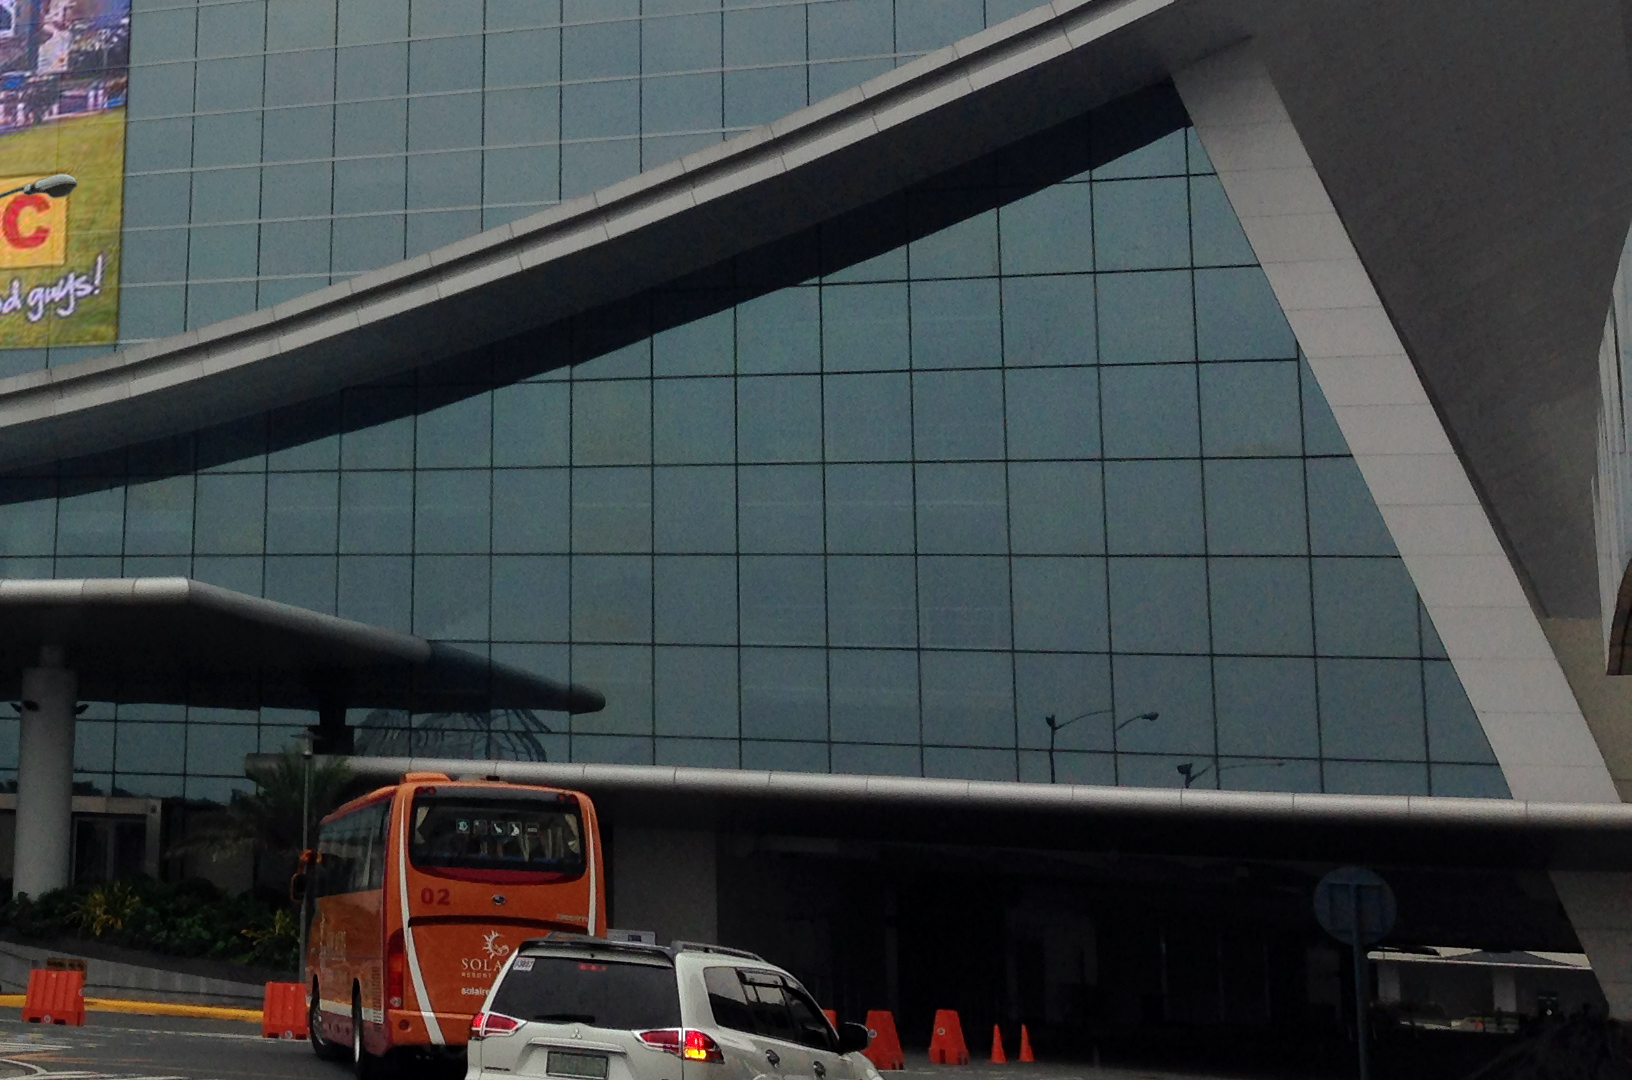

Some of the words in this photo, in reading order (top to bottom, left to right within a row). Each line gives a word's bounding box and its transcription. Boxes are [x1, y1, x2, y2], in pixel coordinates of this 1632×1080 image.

[26, 253, 104, 322] guys!
[420, 887, 451, 906] 02
[460, 957, 503, 973] SOLA
